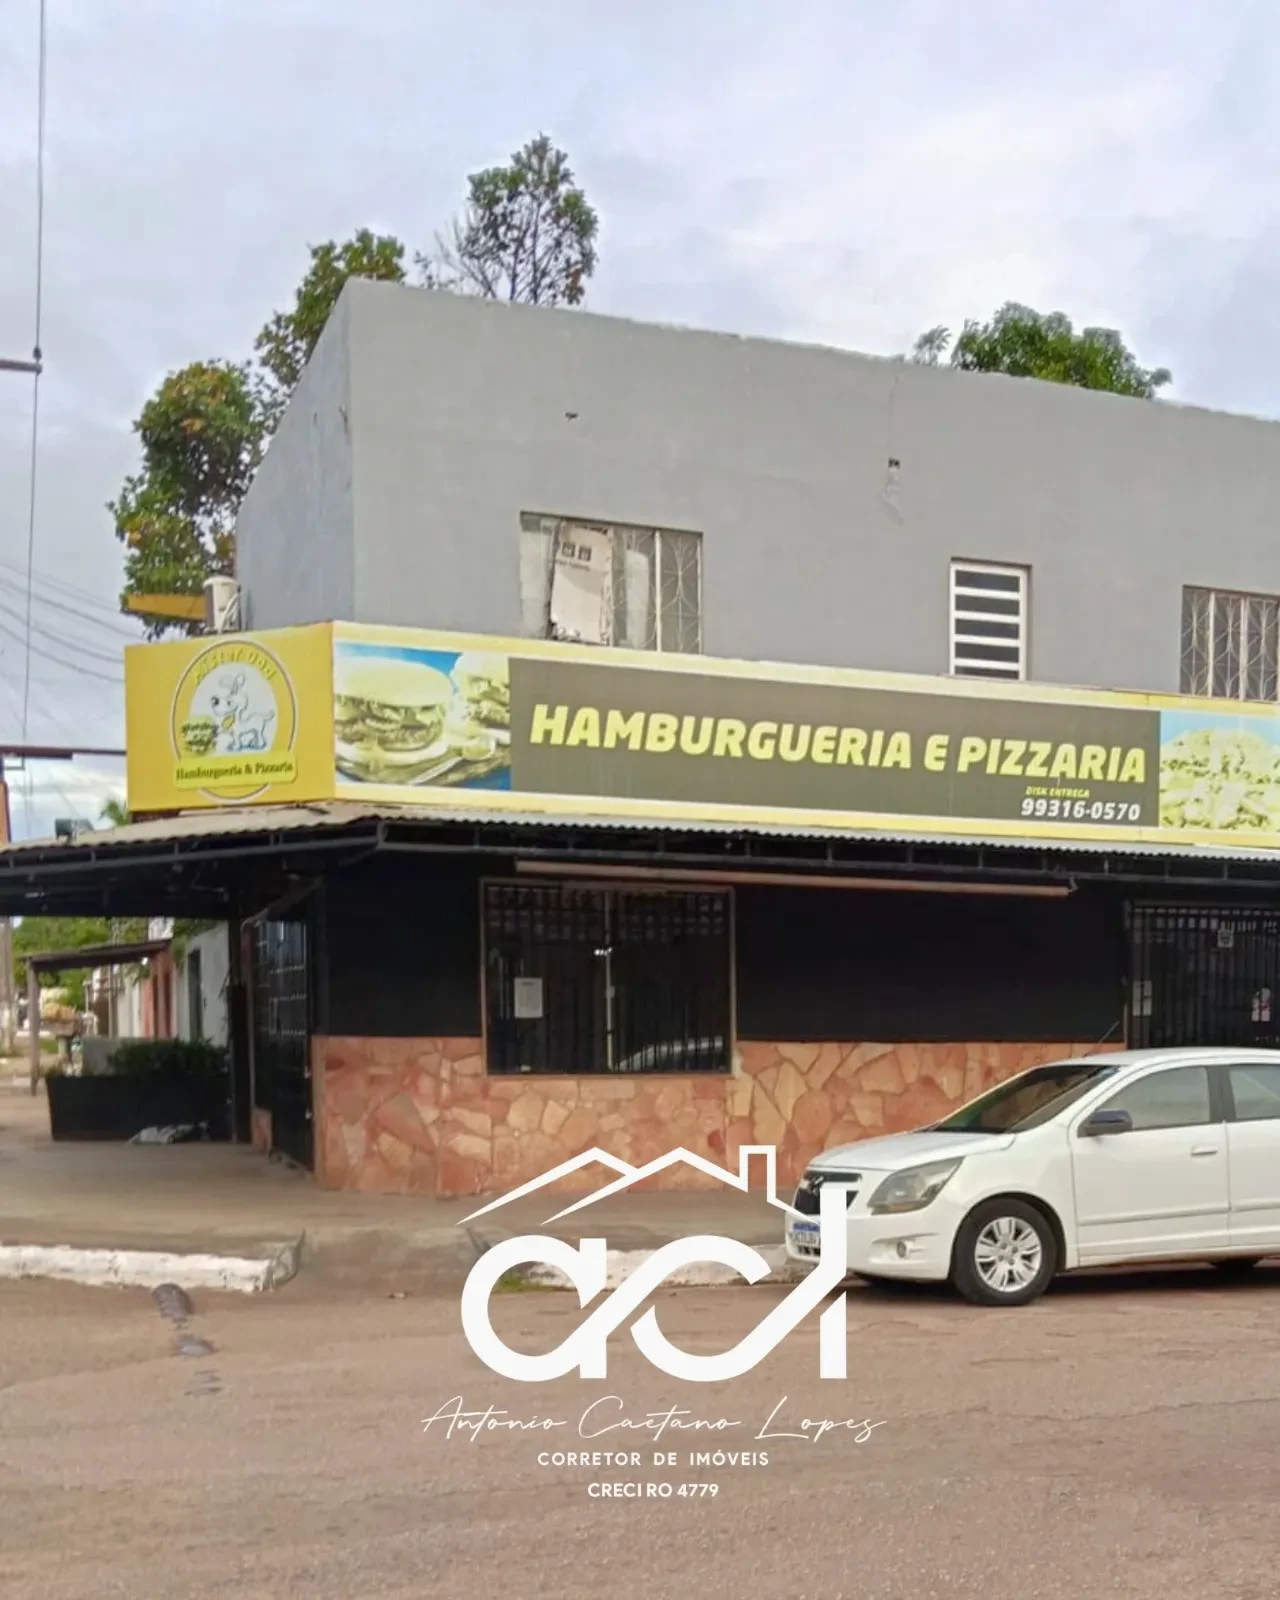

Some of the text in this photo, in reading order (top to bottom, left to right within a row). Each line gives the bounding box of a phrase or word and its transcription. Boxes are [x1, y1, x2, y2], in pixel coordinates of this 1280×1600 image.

[530, 704, 1146, 783] HAMBURGUERIA E PIZZARIA
[1026, 786, 1048, 796] DISK
[1021, 798, 1141, 821] 99316-0570
